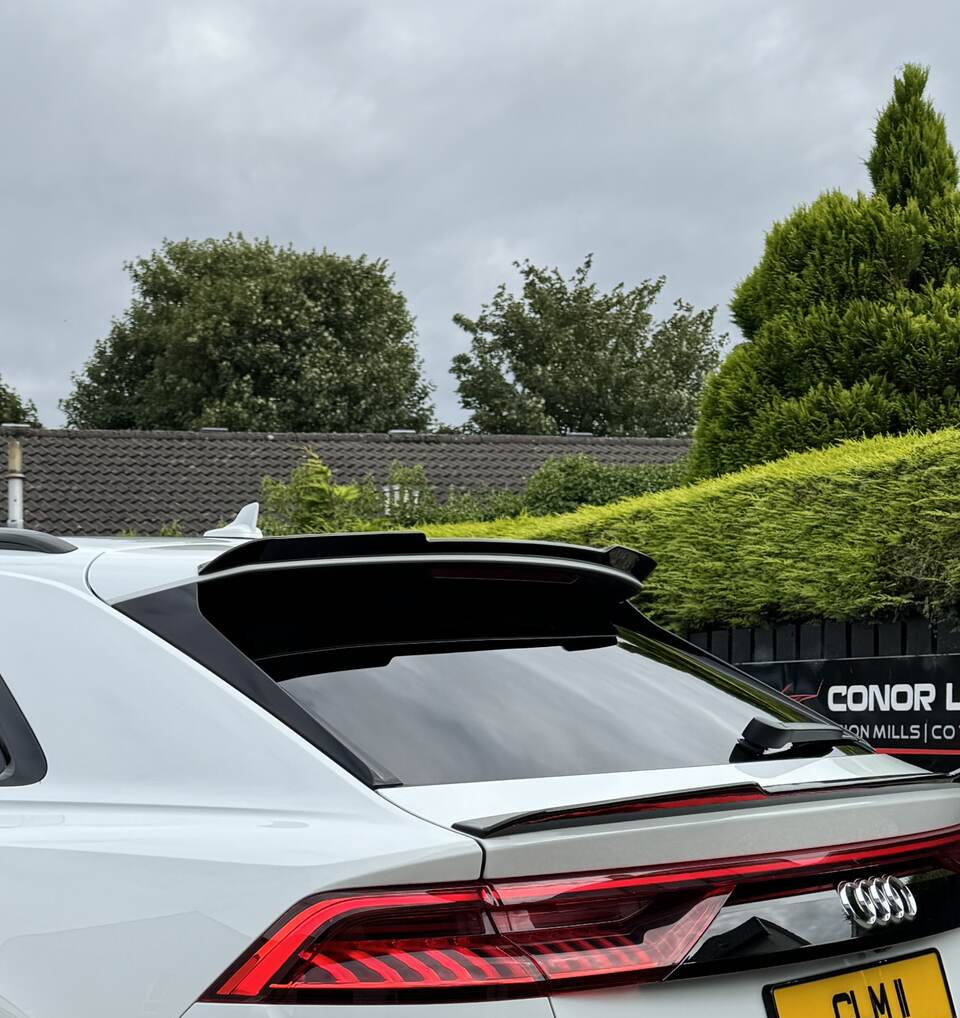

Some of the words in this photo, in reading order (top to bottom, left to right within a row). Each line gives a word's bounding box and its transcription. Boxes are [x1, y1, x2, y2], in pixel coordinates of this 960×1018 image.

[827, 683, 936, 711] CONOR
[873, 725, 920, 739] MILLS
[931, 725, 956, 739] CO
